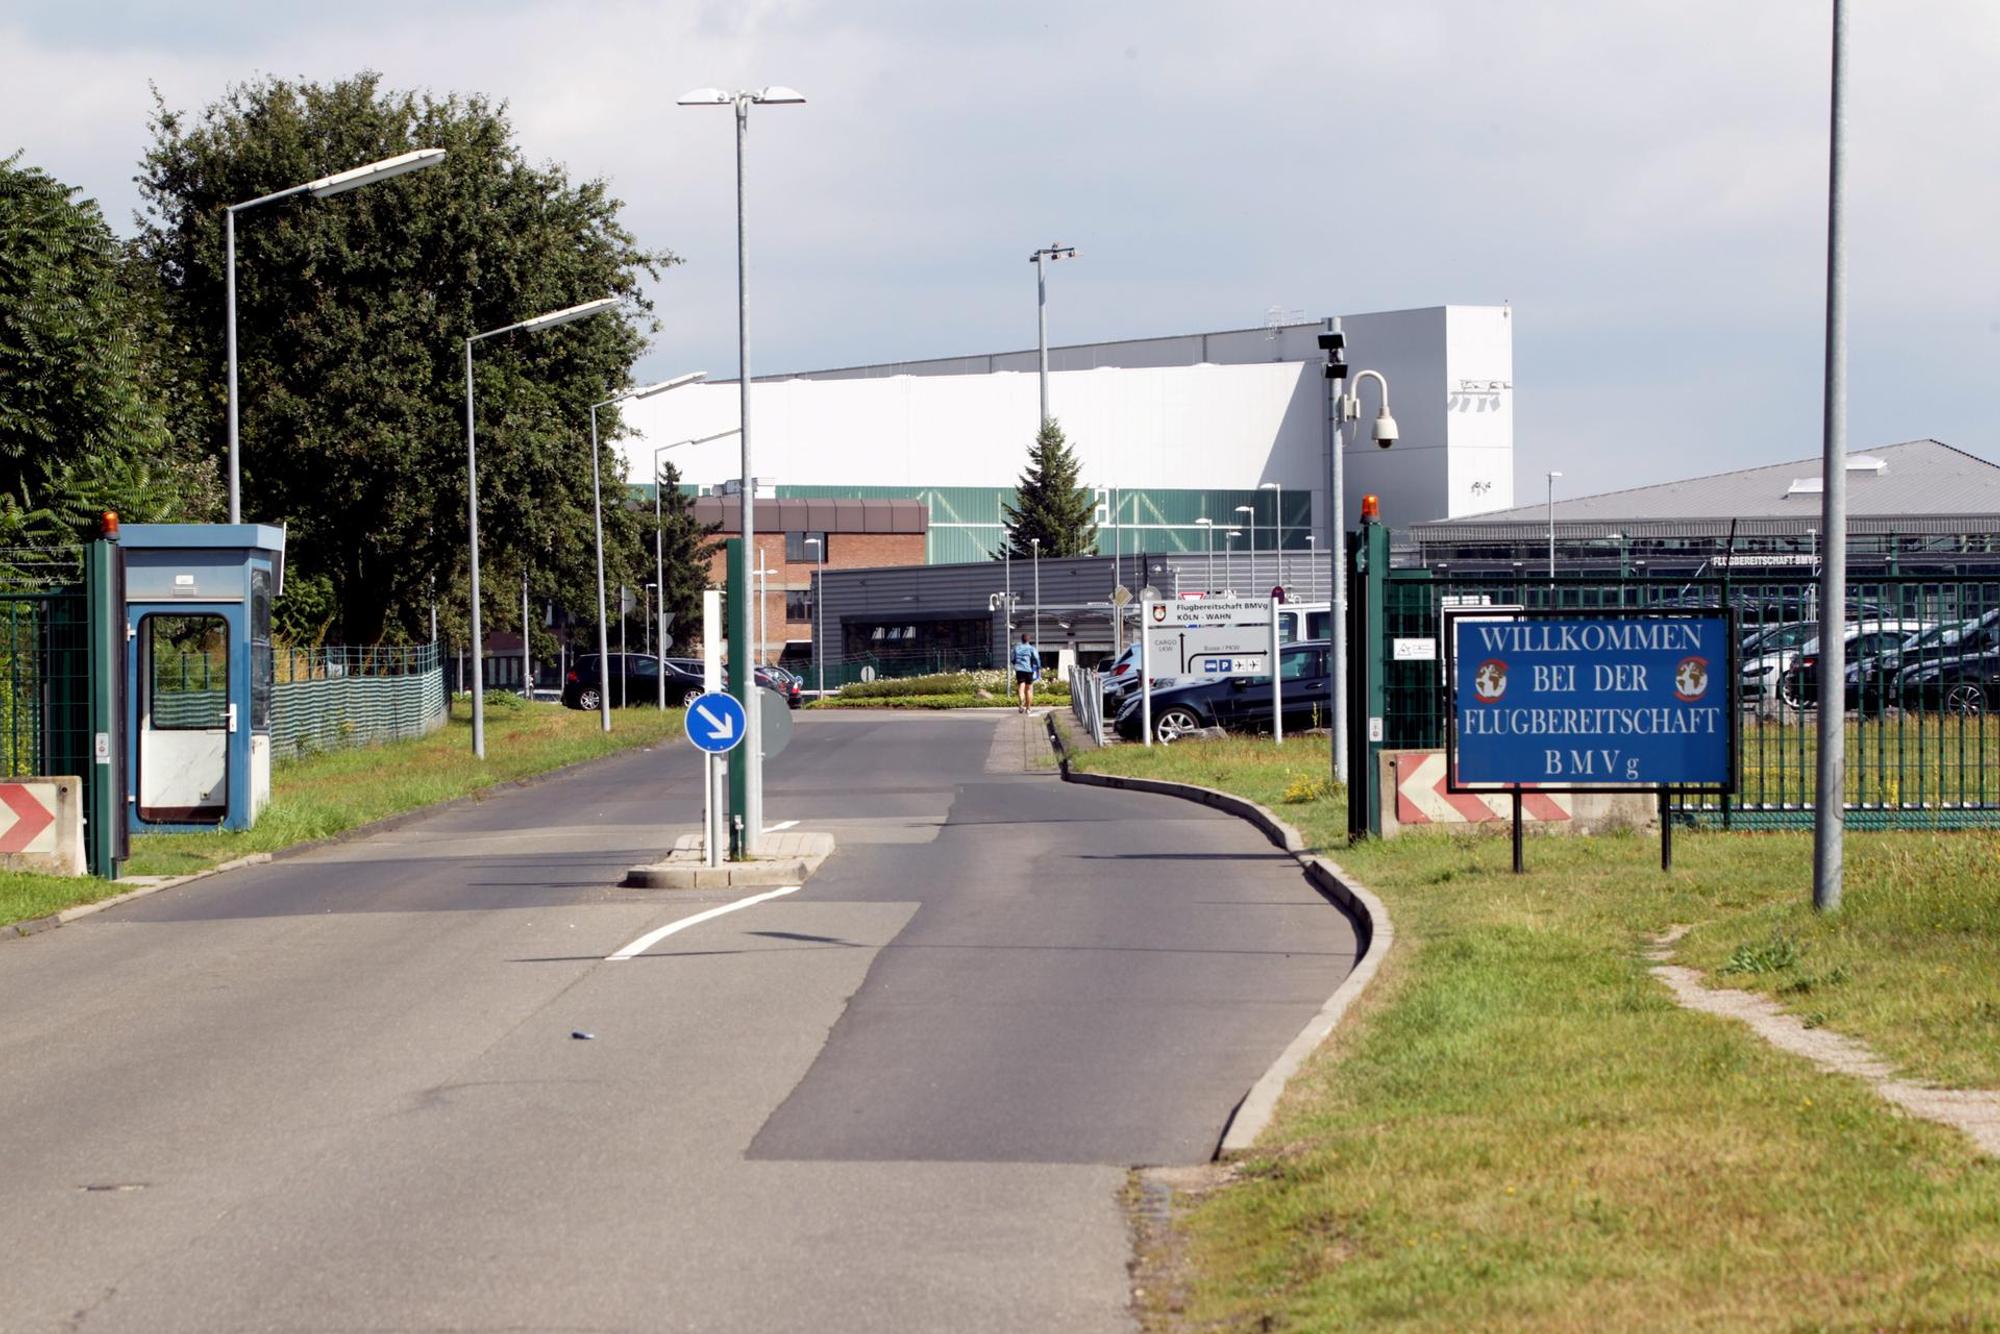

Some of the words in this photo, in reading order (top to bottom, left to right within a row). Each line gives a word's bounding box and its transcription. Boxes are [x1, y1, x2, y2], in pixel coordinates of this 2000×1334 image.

[1176, 603, 1242, 611] Flugbereitschaft
[1244, 603, 1268, 611] BMVg
[1177, 612, 1199, 620] KÖLN
[1479, 624, 1702, 652] WILLKOMMEN
[1533, 665, 1575, 692] BEI
[1593, 665, 1648, 692] DER
[1464, 707, 1719, 735] FLUGBEREITSCHAFT
